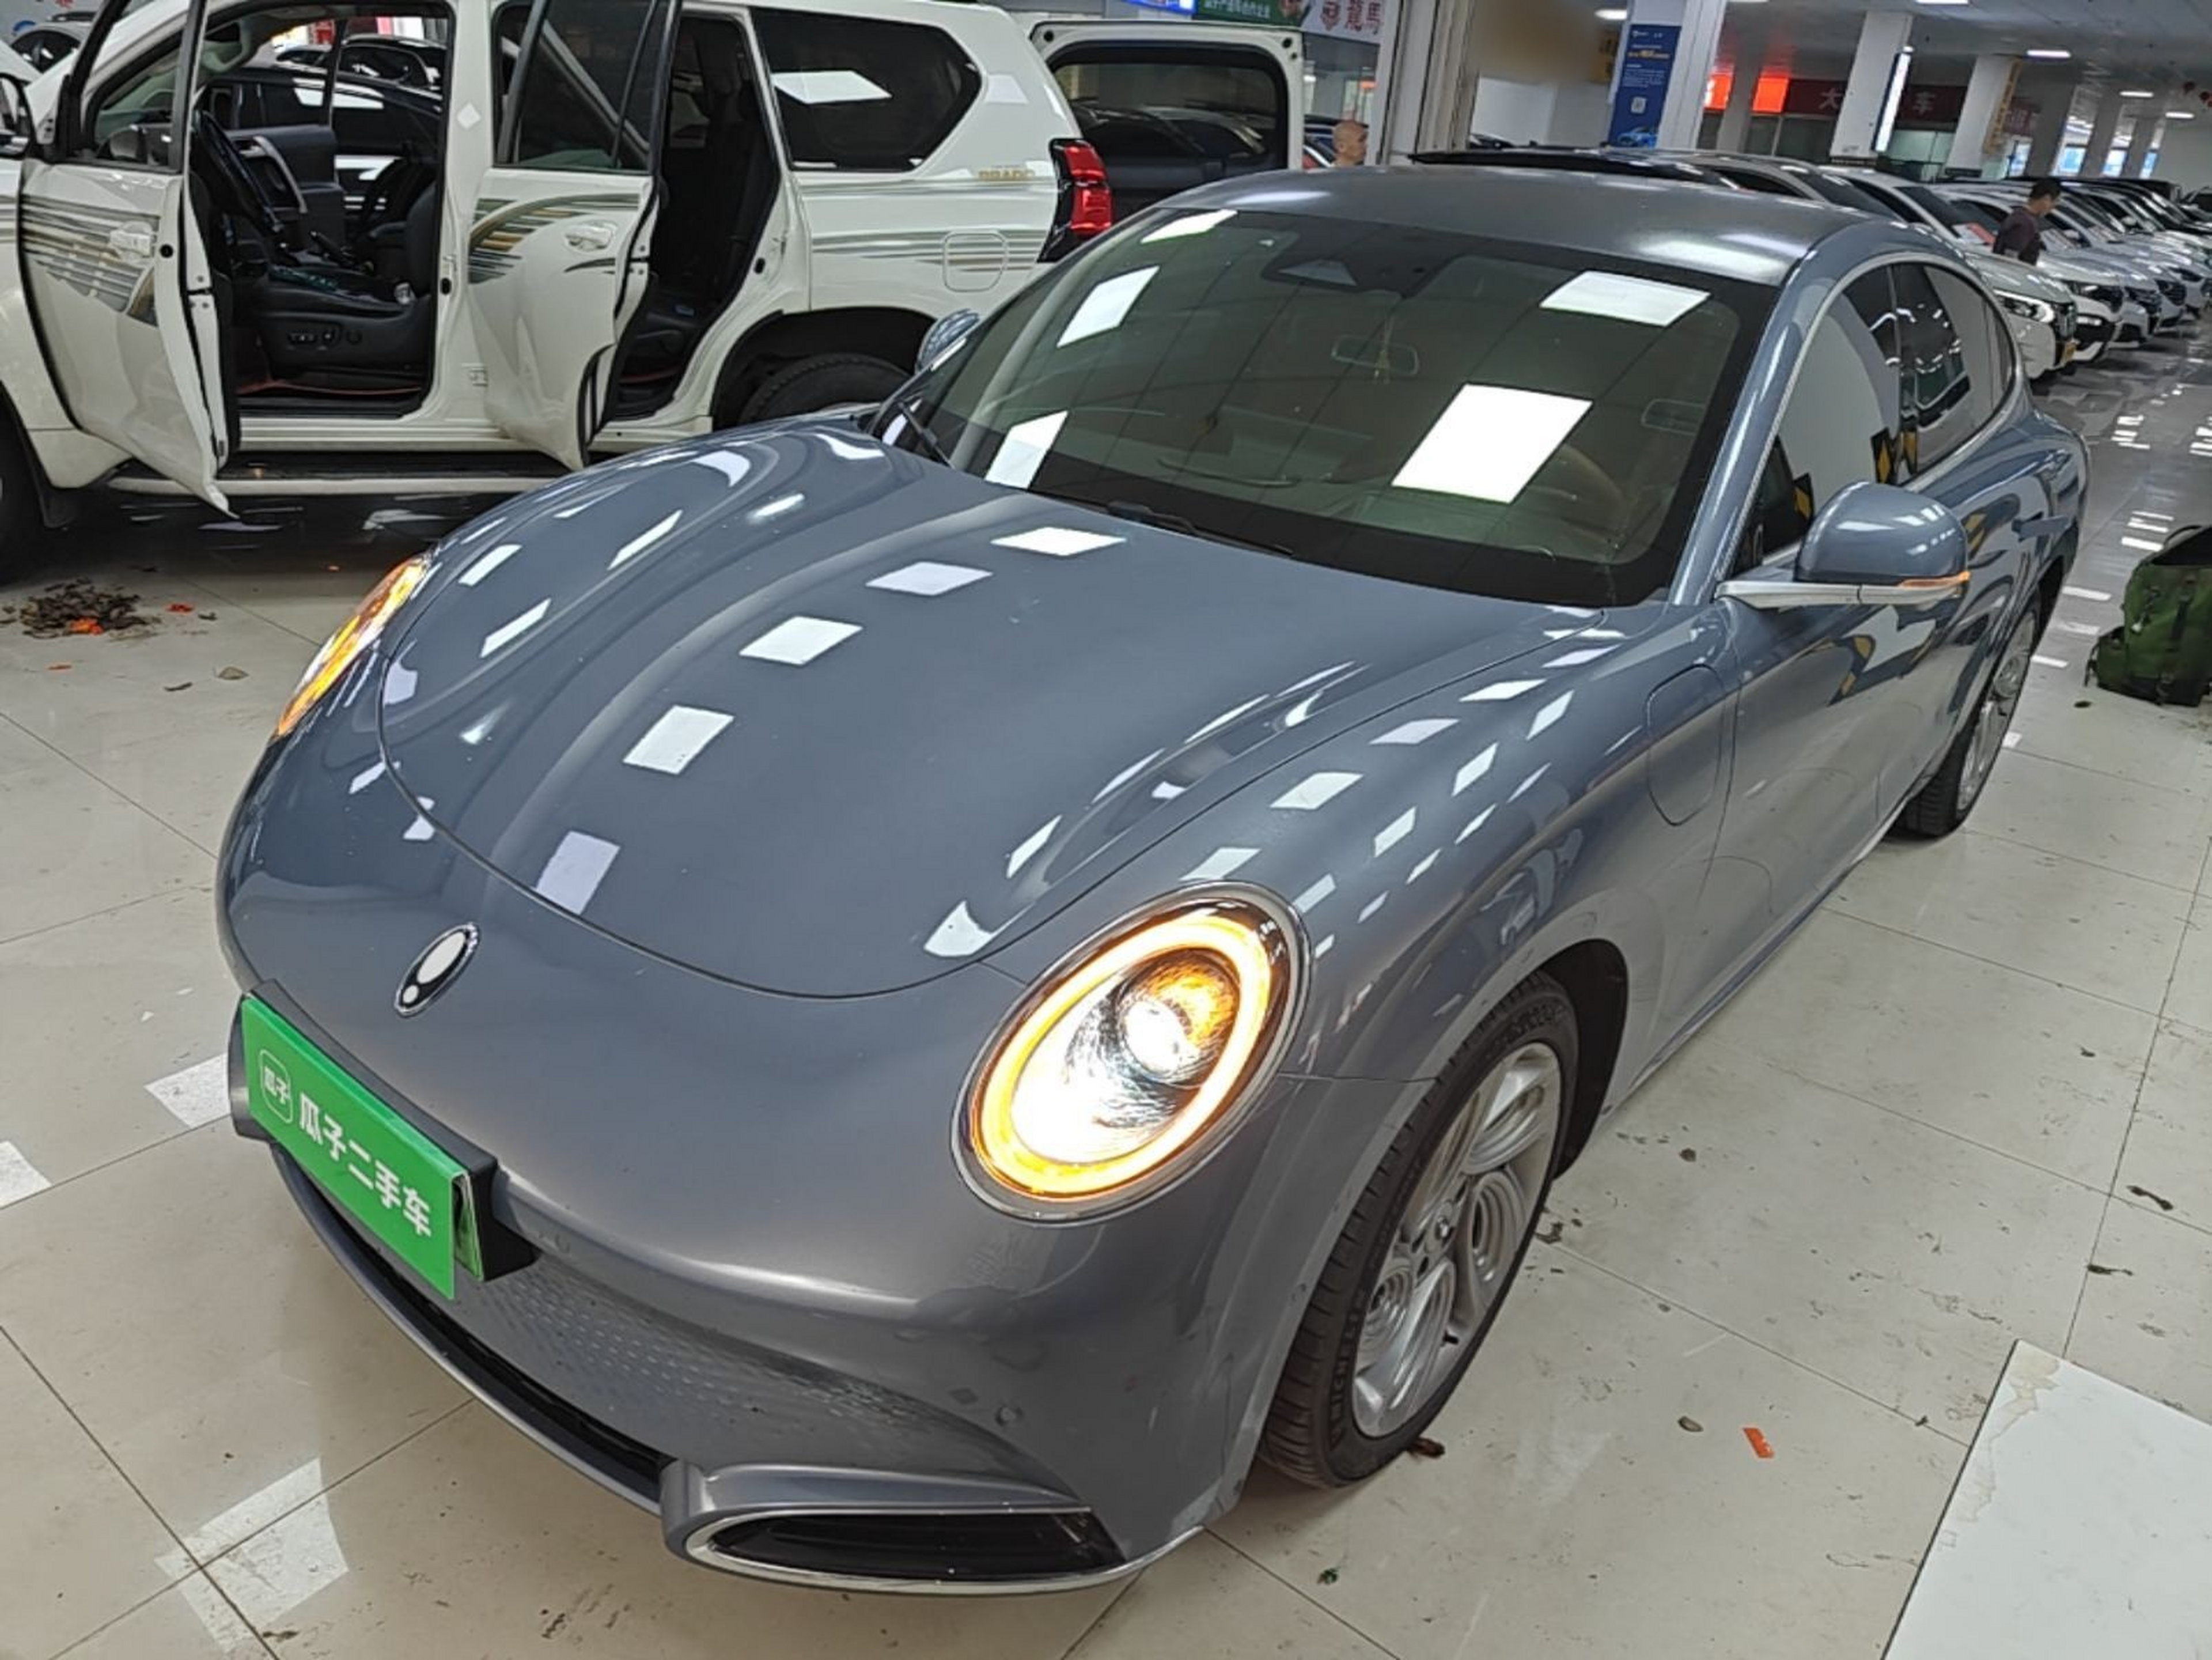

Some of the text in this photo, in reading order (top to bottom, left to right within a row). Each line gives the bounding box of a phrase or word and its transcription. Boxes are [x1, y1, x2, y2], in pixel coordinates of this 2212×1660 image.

[300, 1091, 432, 1238] 瓜子二手车
